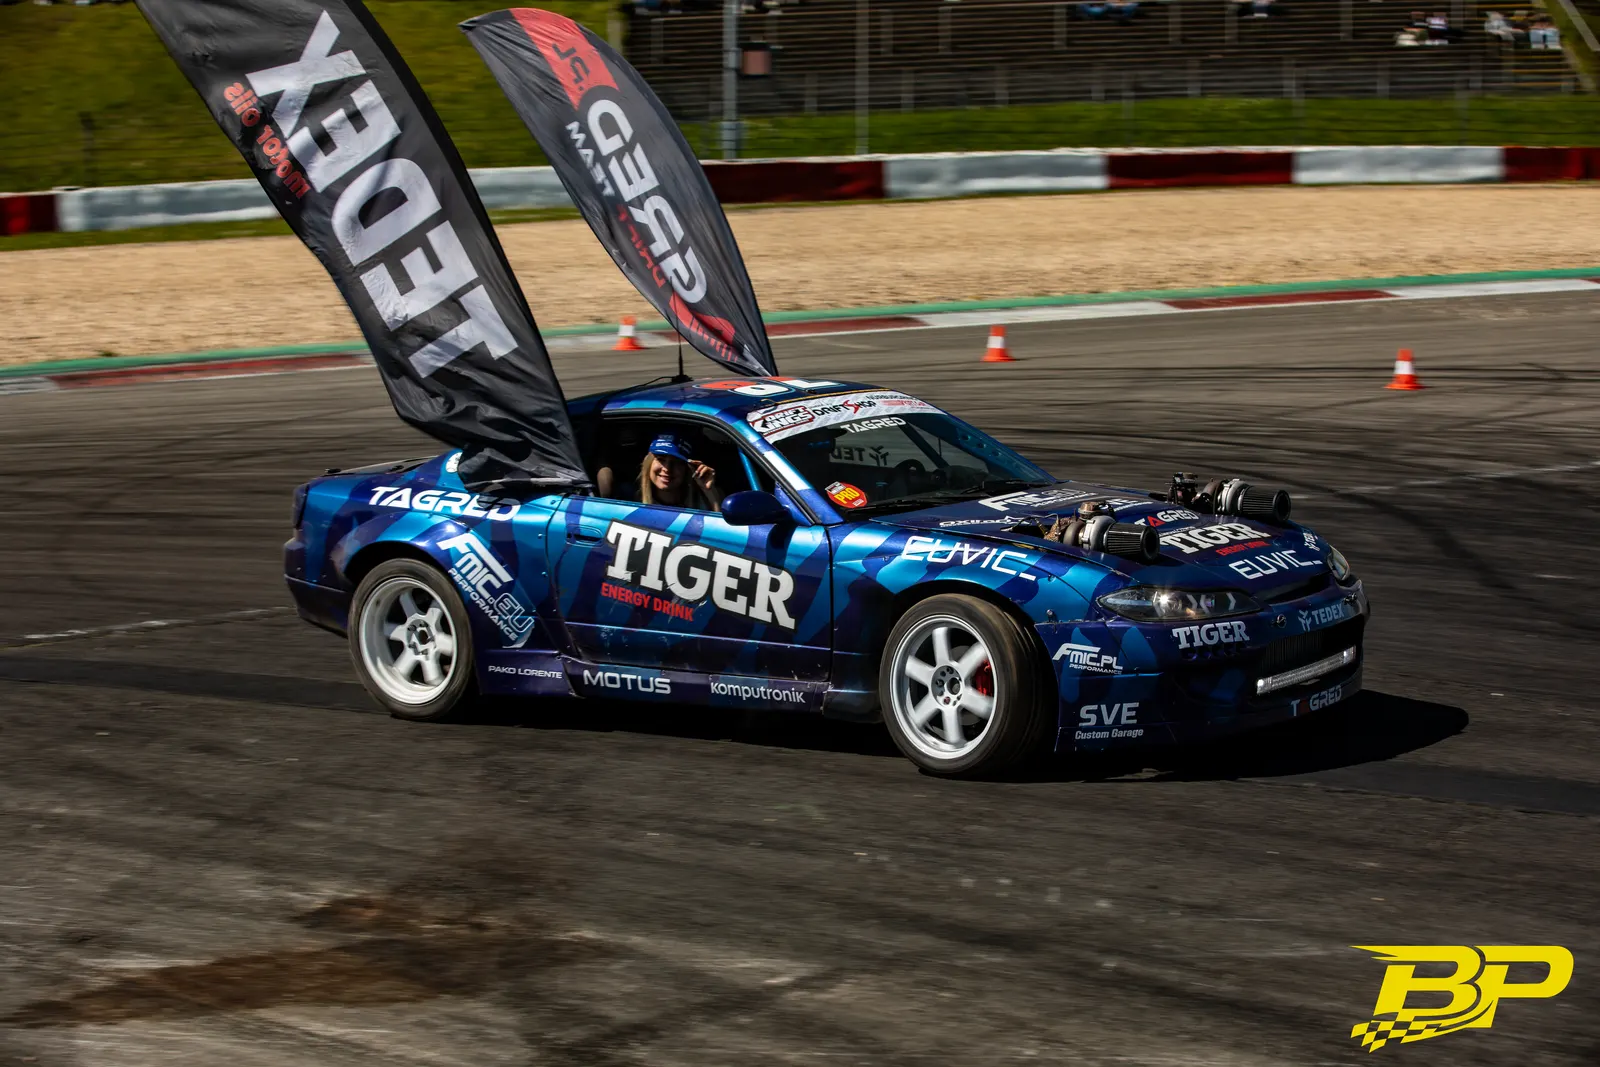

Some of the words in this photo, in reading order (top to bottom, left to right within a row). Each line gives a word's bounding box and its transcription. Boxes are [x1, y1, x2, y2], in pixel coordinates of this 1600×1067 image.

[840, 416, 907, 434] TAGRED
[368, 486, 522, 521] TAGRED
[834, 487, 861, 504] PRO
[1134, 508, 1200, 528] TAGRED
[1159, 522, 1272, 555] TIGER
[605, 519, 797, 631] TIGER
[448, 567, 519, 642] PERFORMANCE
[601, 581, 652, 606] ENERGY
[652, 597, 694, 622] DRINK
[1311, 602, 1345, 625] TEDEX
[1171, 620, 1250, 650] TIGER
[488, 664, 516, 675] PAKO
[517, 667, 563, 680] LORENTE
[582, 668, 672, 695] MOTUS
[1068, 662, 1123, 676] PERFORMANCE
[1078, 702, 1140, 728] SVE
[1075, 728, 1110, 741] Custom
[1111, 727, 1145, 740] Garage
